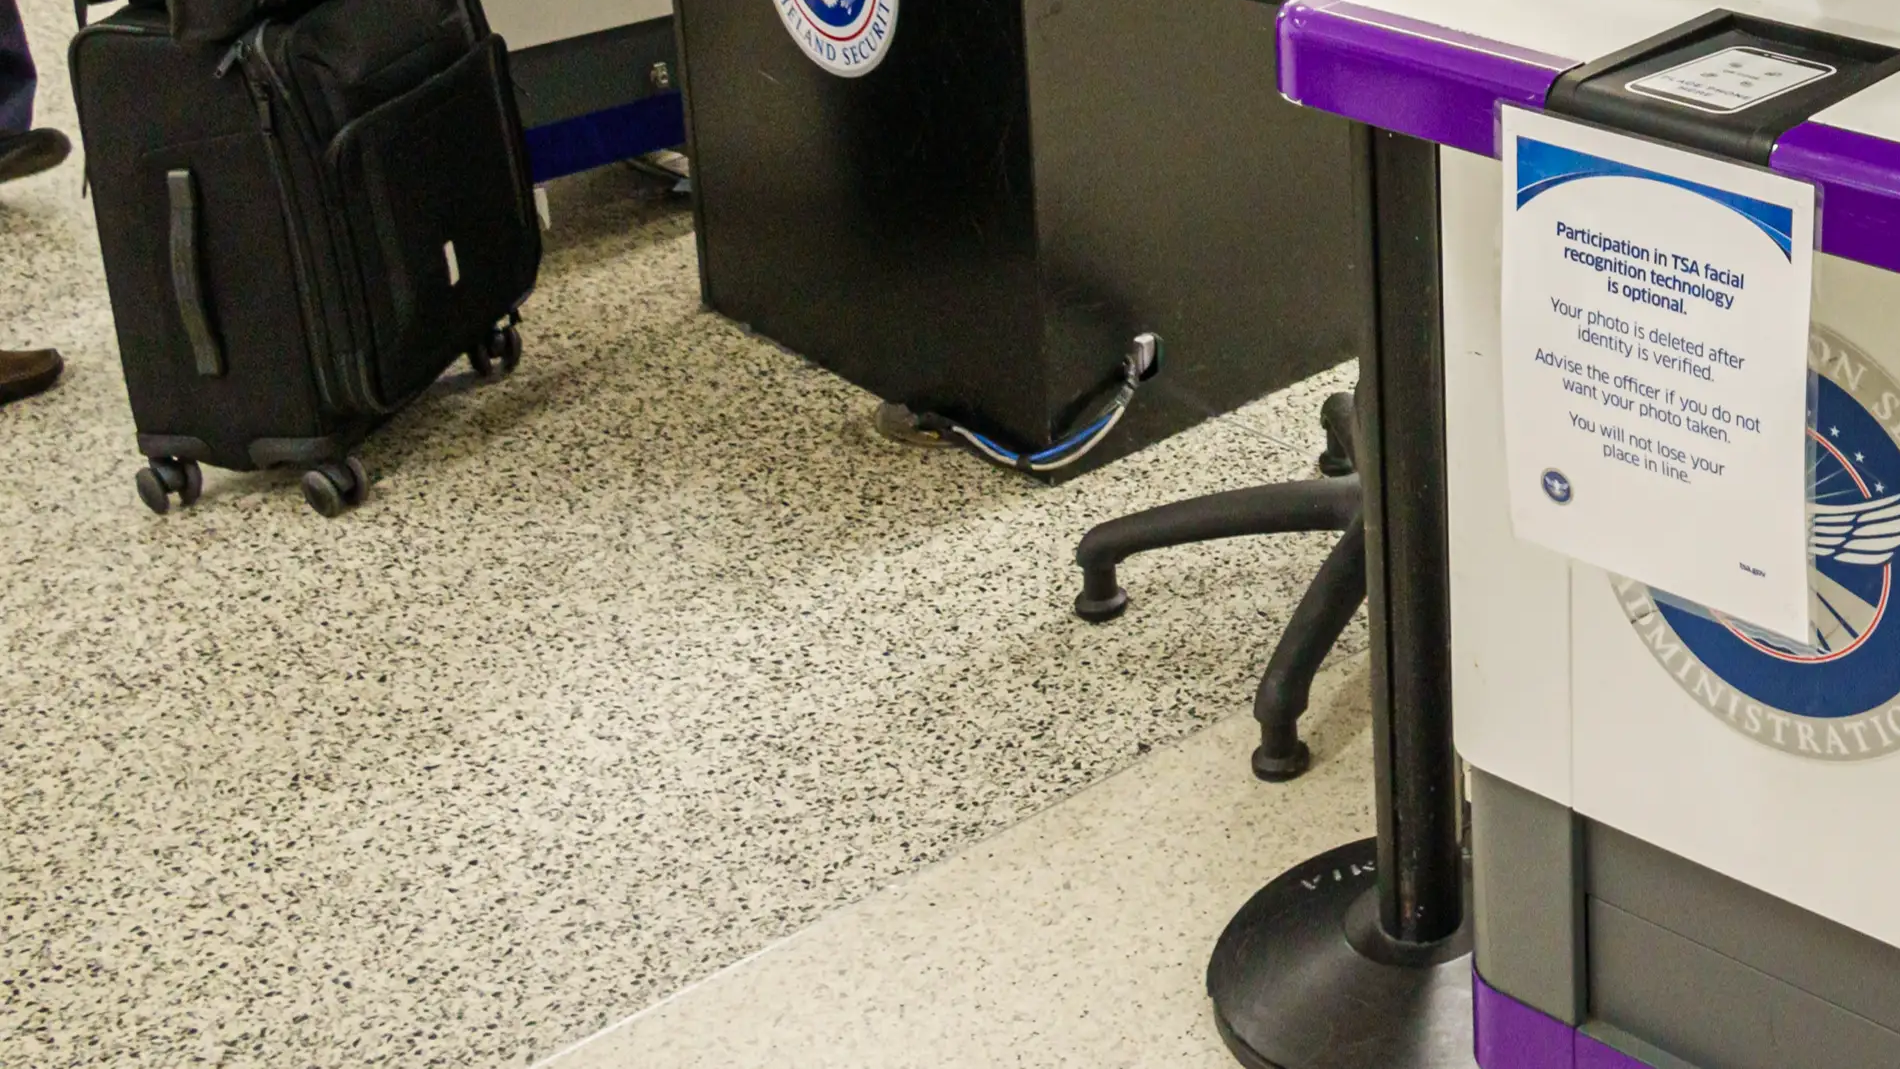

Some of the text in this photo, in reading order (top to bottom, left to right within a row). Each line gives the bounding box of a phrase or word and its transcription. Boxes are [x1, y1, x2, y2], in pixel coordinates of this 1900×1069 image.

[1556, 221, 1744, 290] Participation in TSA facial
[1564, 246, 1734, 310] recognition technology
[1608, 276, 1687, 315] is optional.
[1551, 296, 1745, 370] Your photo is deleted after
[1578, 325, 1714, 382] identity is verified.
[1535, 348, 1760, 433] Advise the officer if you do not
[1562, 378, 1730, 443] want your photo taken.
[1569, 411, 1725, 475] You will not lose your
[1603, 444, 1691, 483] place in line.
